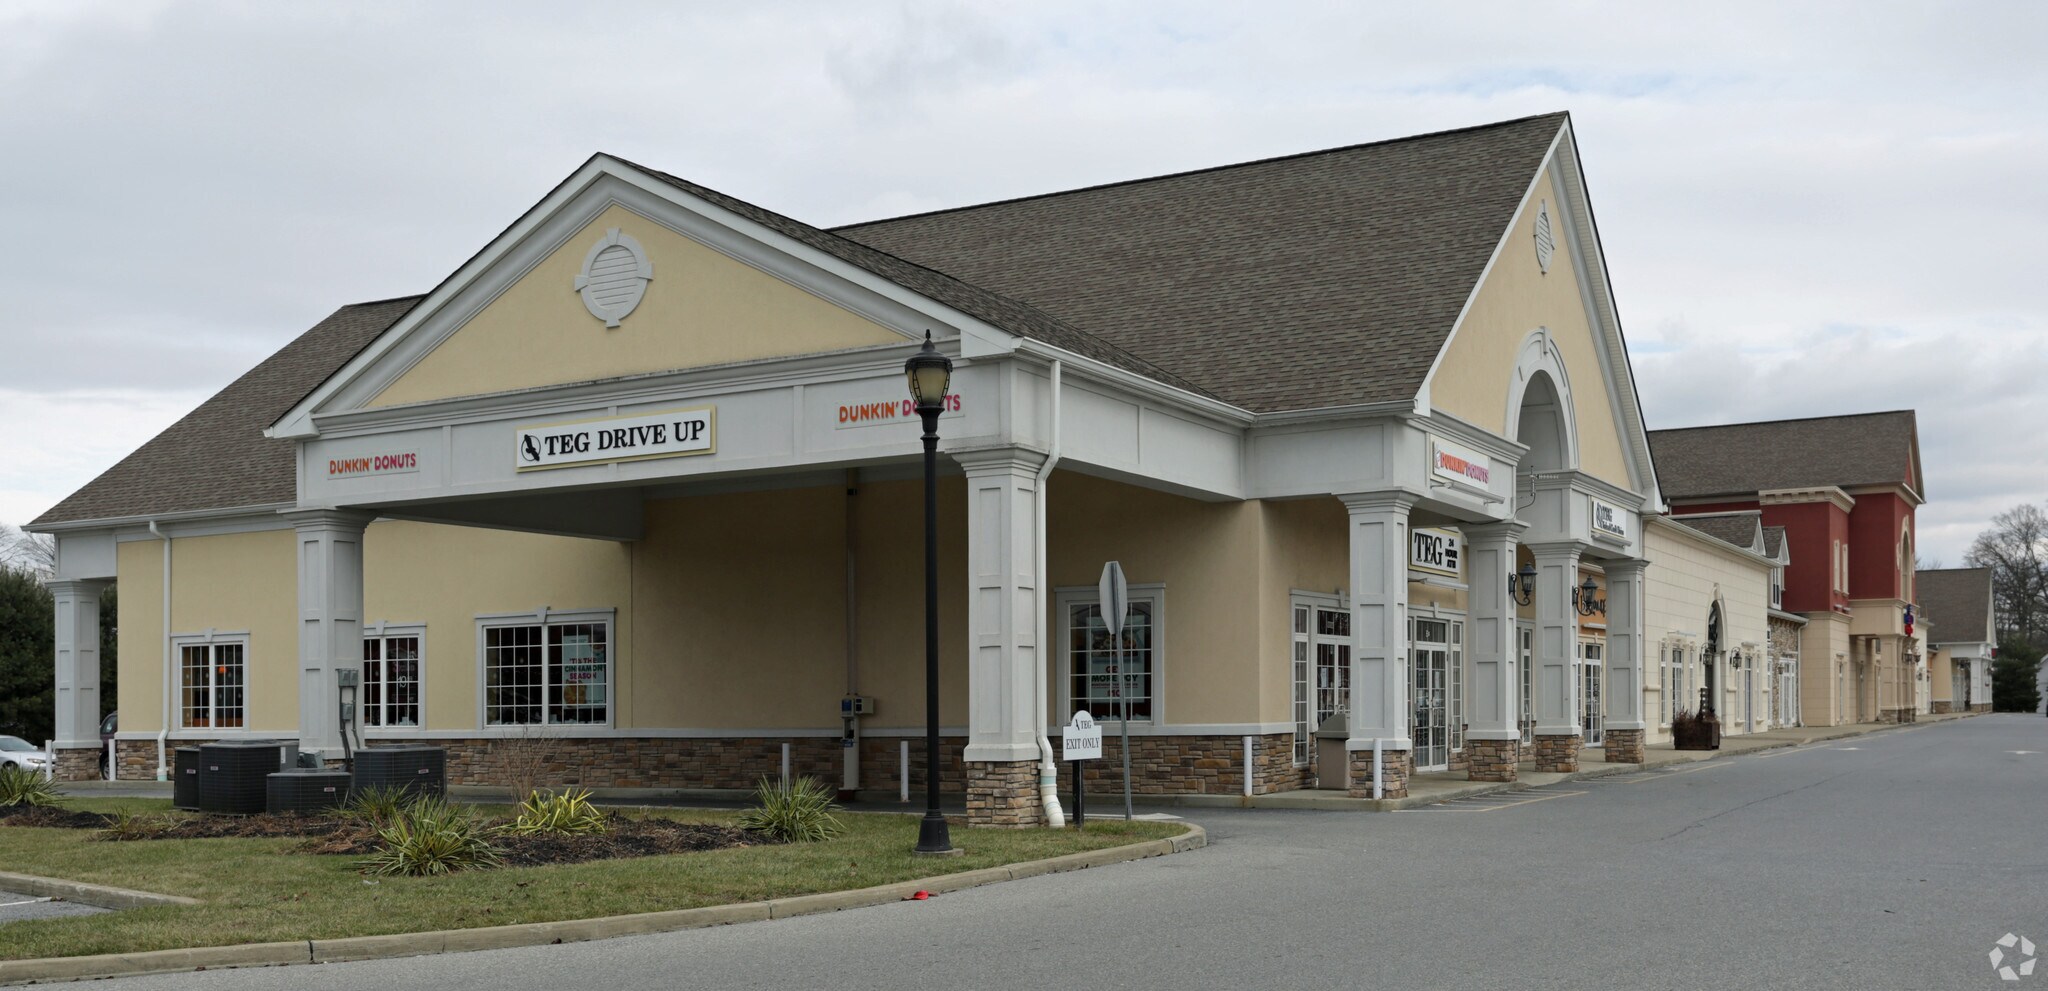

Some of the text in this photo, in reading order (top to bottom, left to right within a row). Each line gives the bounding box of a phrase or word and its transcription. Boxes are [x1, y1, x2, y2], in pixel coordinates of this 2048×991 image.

[839, 401, 899, 423] DUNKIN'
[545, 419, 706, 456] TEG DRIVE UP
[329, 452, 416, 475] DUNKIN' DONUTS
[1414, 532, 1443, 566] TEG
[1091, 674, 1118, 682] MORE
[1081, 720, 1092, 730] TEG
[1066, 737, 1100, 750] EXIT ONLY
